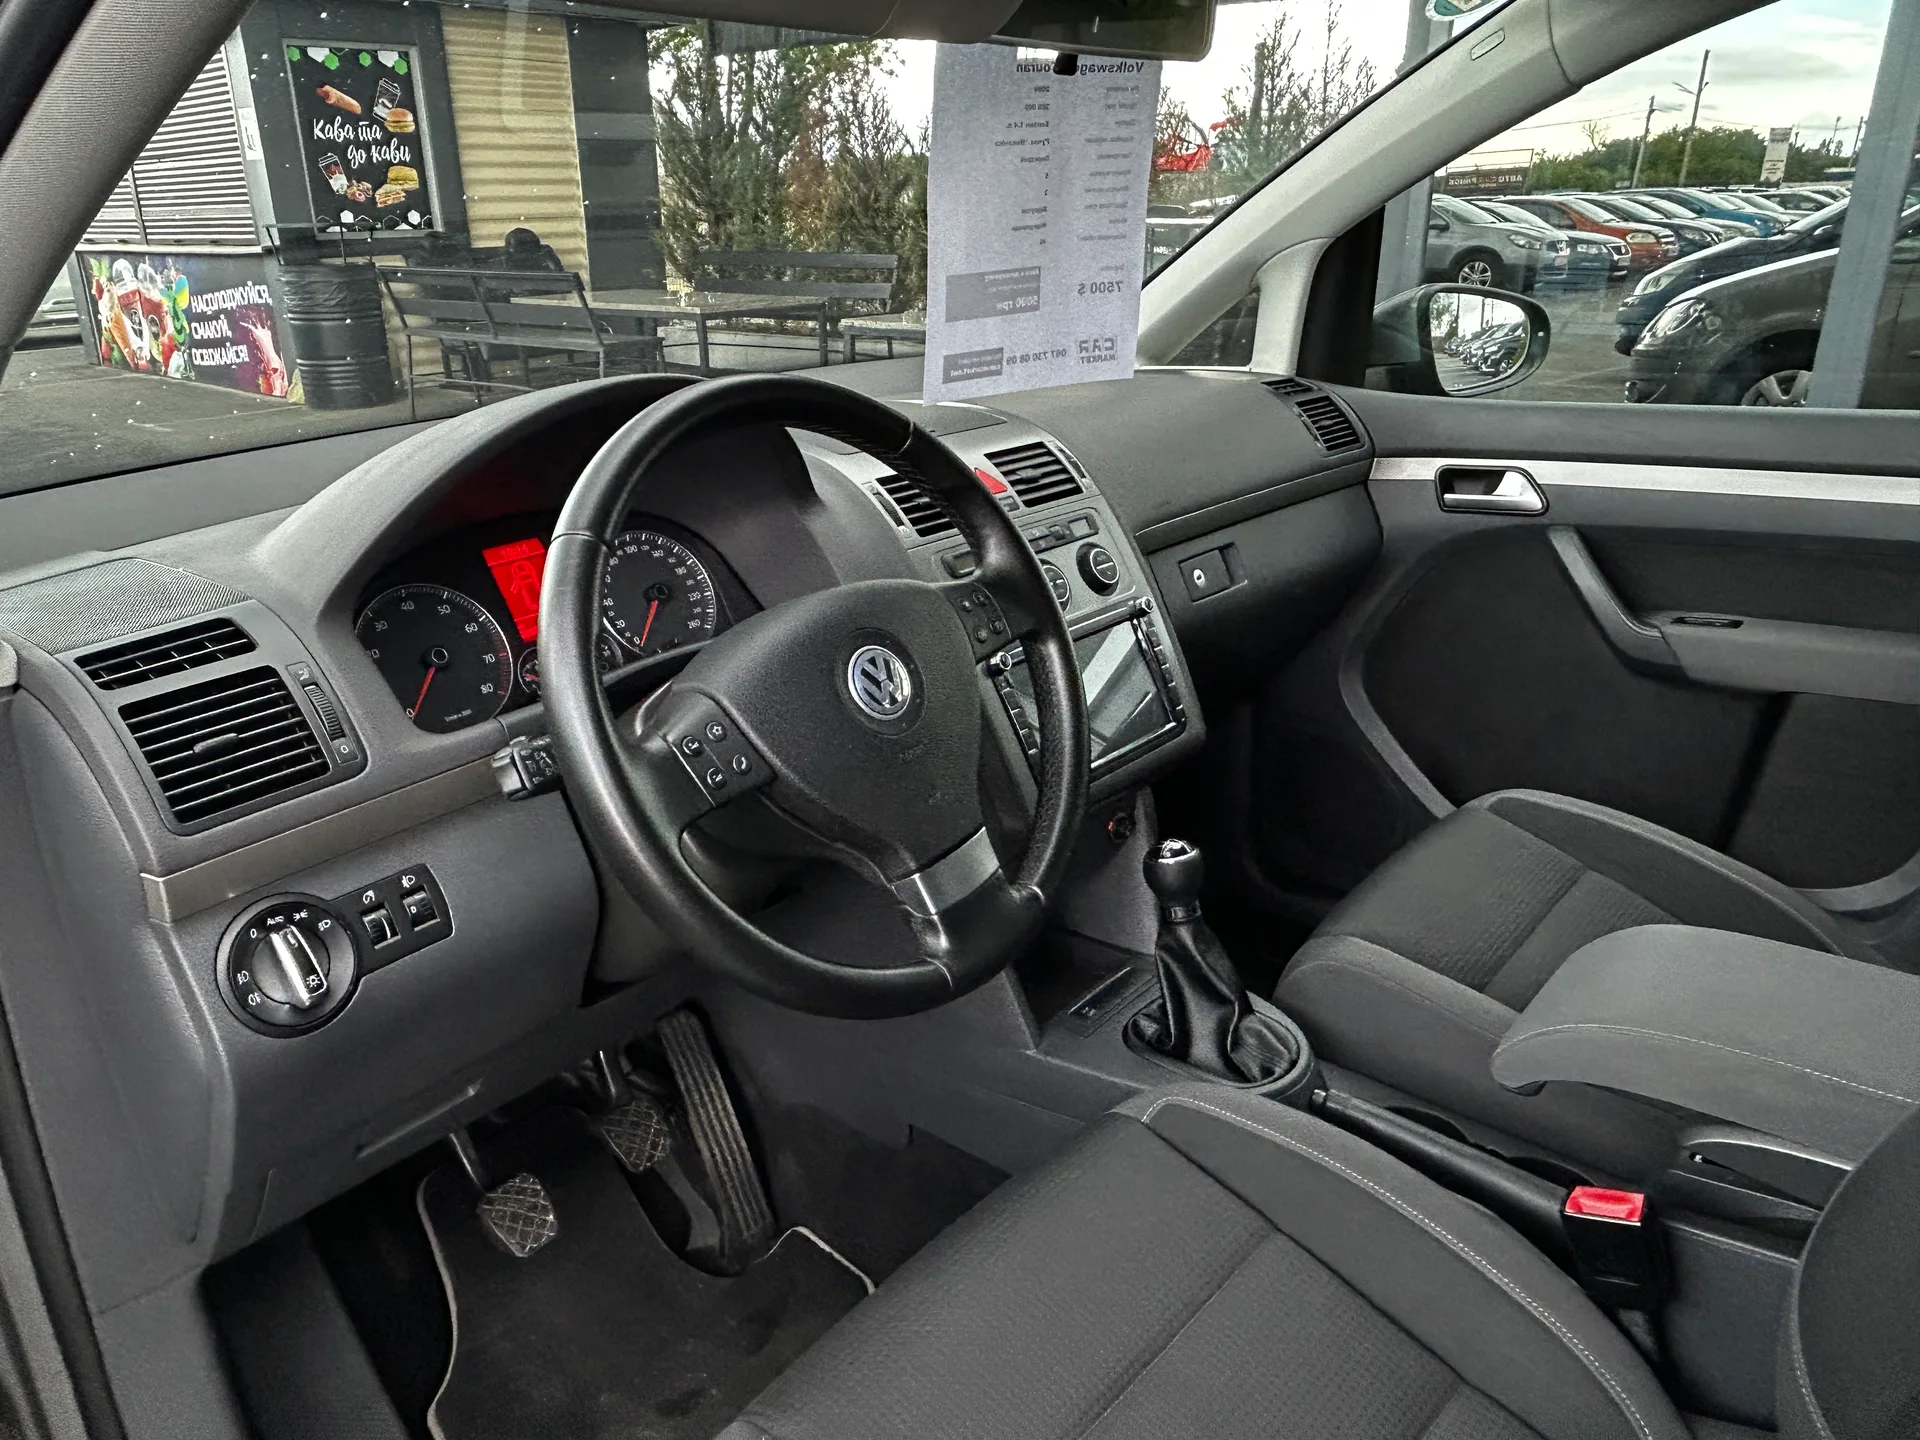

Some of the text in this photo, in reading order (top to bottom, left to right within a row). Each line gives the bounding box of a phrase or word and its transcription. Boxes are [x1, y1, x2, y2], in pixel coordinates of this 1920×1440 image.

[313, 115, 383, 142] Кава та
[347, 137, 411, 168] до кави
[401, 600, 415, 610] 40
[438, 604, 451, 615] 50
[375, 620, 388, 631] 30
[465, 622, 479, 633] 60
[615, 619, 626, 629] 20
[634, 636, 641, 645] 0
[483, 654, 496, 664] 70
[480, 683, 494, 694] 80
[250, 928, 257, 939] 0
